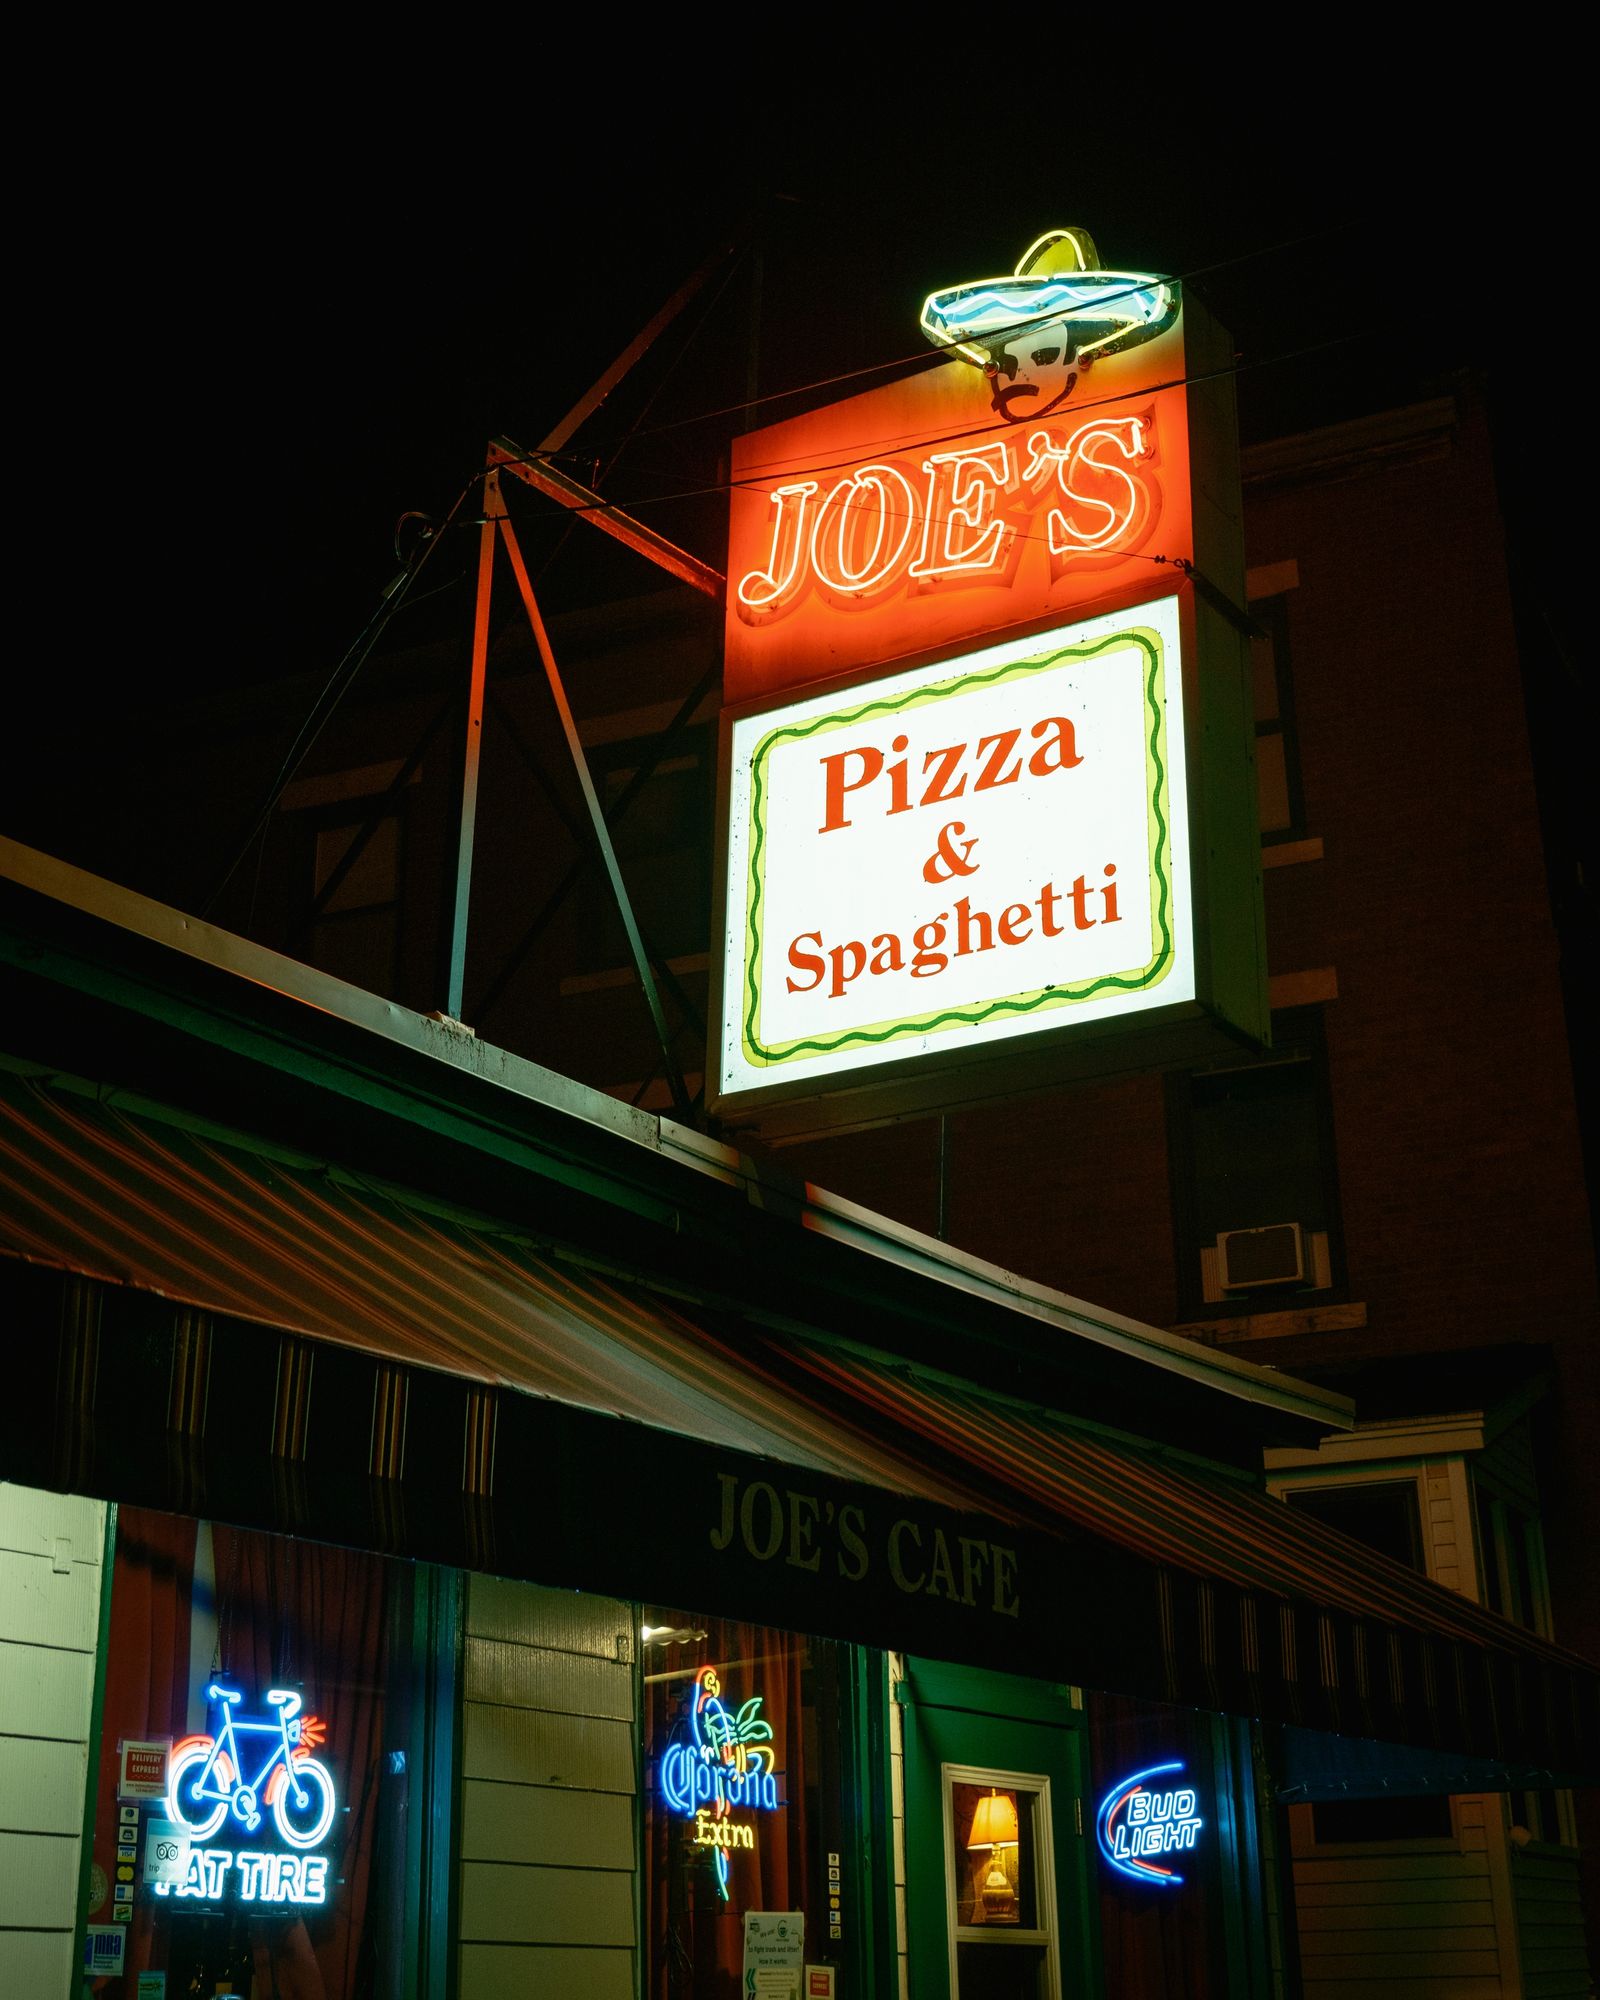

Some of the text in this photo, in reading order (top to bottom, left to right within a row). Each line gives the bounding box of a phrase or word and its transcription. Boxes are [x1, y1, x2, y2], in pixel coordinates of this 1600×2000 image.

[738, 416, 1149, 606] JOE'S
[817, 715, 1085, 835] Pizza
[922, 820, 981, 885] &
[785, 863, 1123, 999] Spaghetti
[708, 1472, 1022, 1619] JOE'S CAFE
[131, 1753, 162, 1763] DELIVERY
[131, 1764, 160, 1774] EXPRESS
[661, 1743, 778, 1818] Corona
[693, 1808, 755, 1849] Extra
[1126, 1789, 1196, 1826] BUD
[1113, 1817, 1203, 1860] LIGHT
[235, 1851, 328, 1905] TIRE
